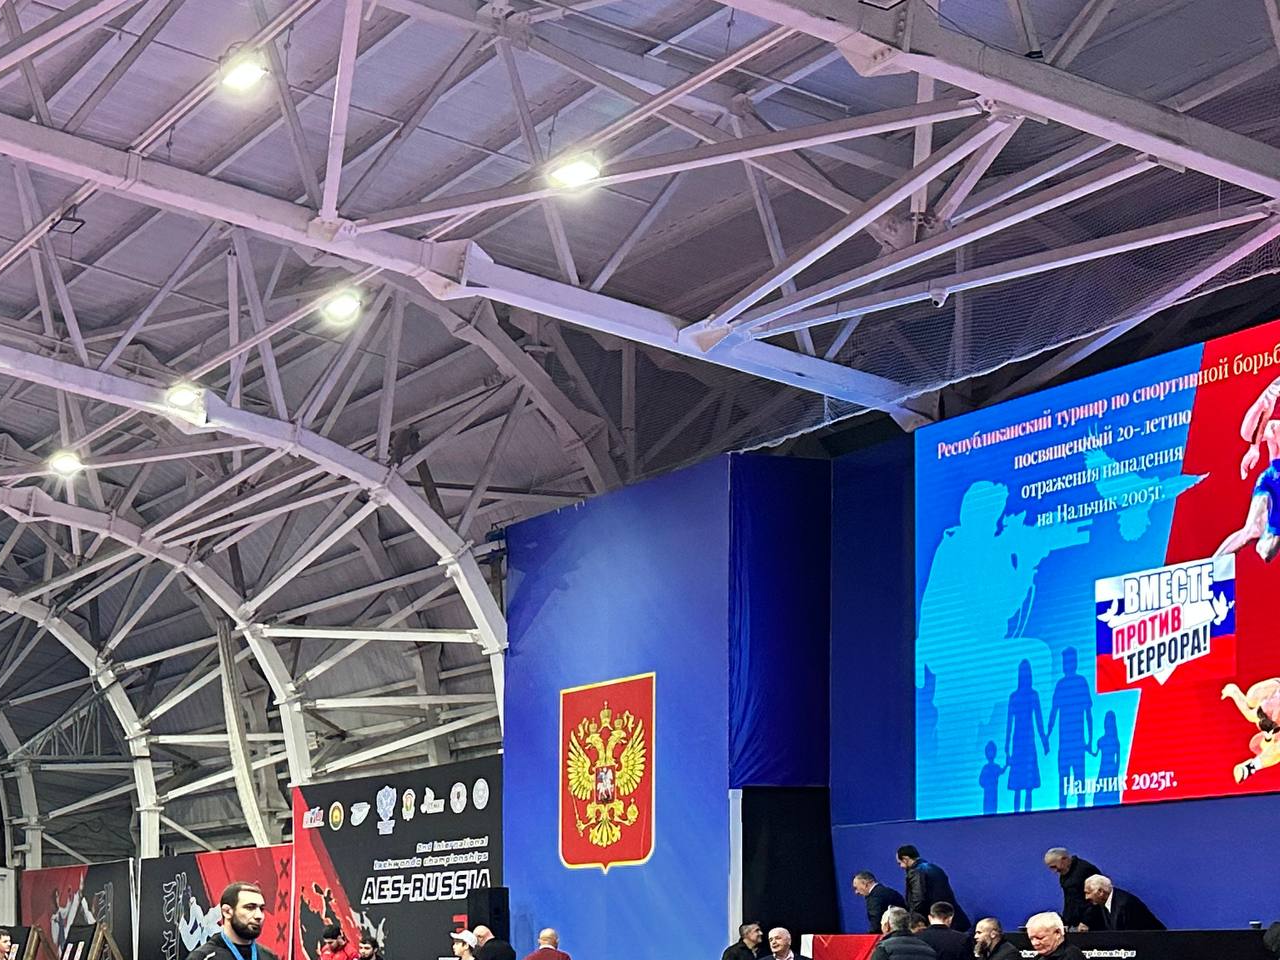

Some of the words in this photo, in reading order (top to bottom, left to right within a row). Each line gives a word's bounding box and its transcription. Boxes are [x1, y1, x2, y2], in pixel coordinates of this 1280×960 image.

[937, 409, 1052, 459] Республиканский
[1055, 399, 1108, 427] турнир
[1111, 392, 1129, 410] по
[1132, 358, 1229, 402] спортивной
[1014, 425, 1112, 469] посвященный
[1117, 410, 1192, 442] 20-летию
[1021, 467, 1099, 500] отражения
[1103, 446, 1183, 479] нападения
[1037, 511, 1053, 527] на
[1057, 497, 1117, 522] Нальчик
[1124, 562, 1214, 615] ВМЕСТЕ
[1115, 606, 1182, 655] ПРОТИВ
[1127, 624, 1208, 679] ТЕРРОРА!
[1063, 776, 1128, 796] Нальчик
[361, 869, 491, 904] AES-RUSSIA
